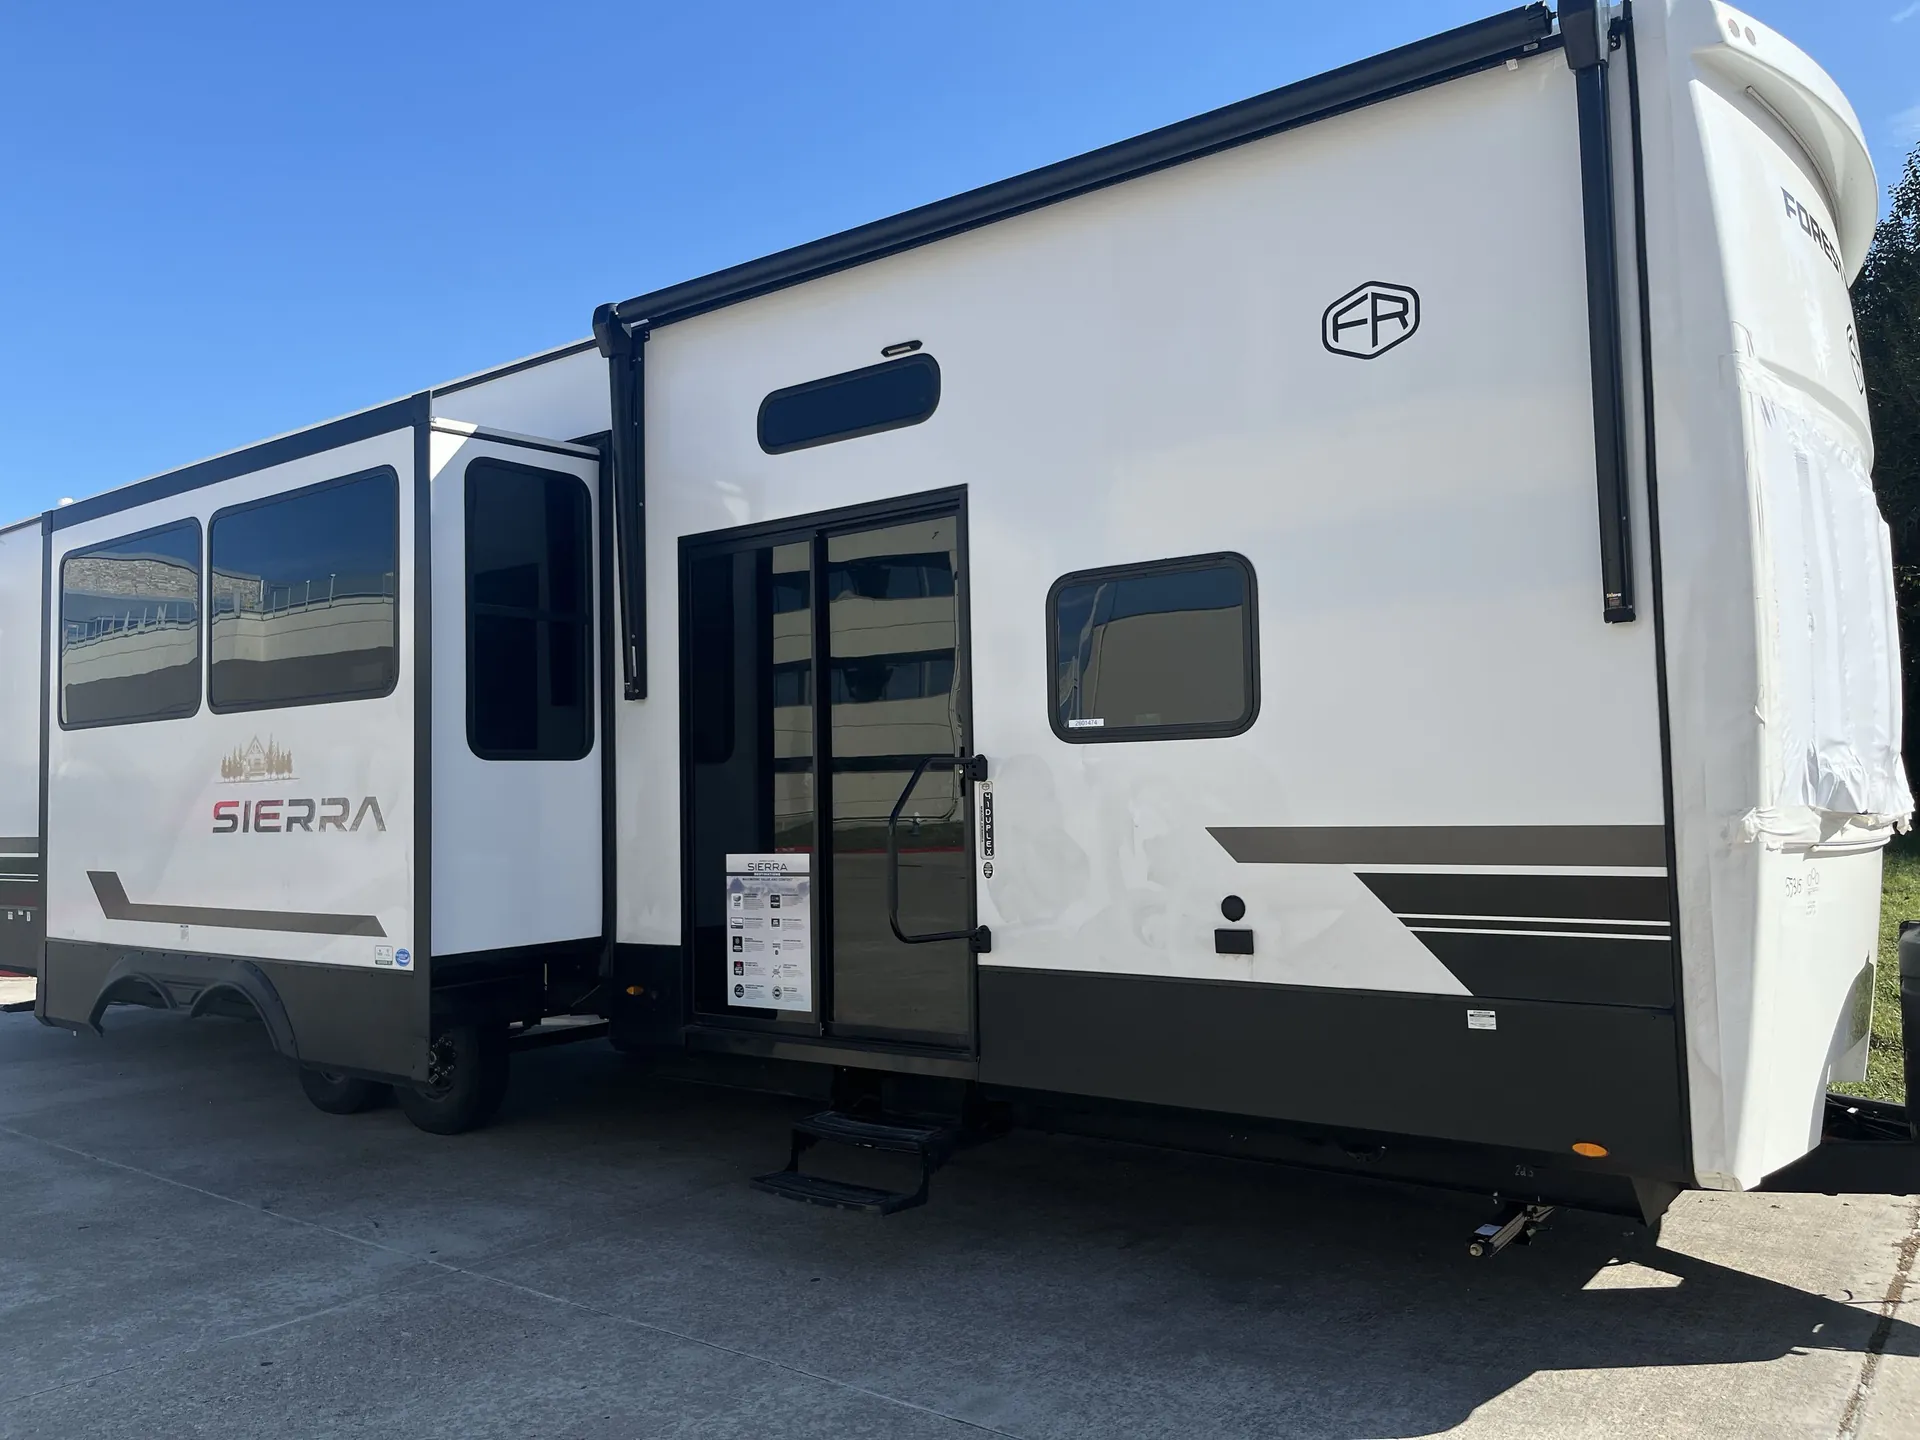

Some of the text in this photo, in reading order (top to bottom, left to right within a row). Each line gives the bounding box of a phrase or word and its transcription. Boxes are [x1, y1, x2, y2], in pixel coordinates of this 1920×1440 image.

[1332, 290, 1410, 349] FR
[212, 796, 387, 834] SIERRA
[747, 862, 788, 871] SIERRA
